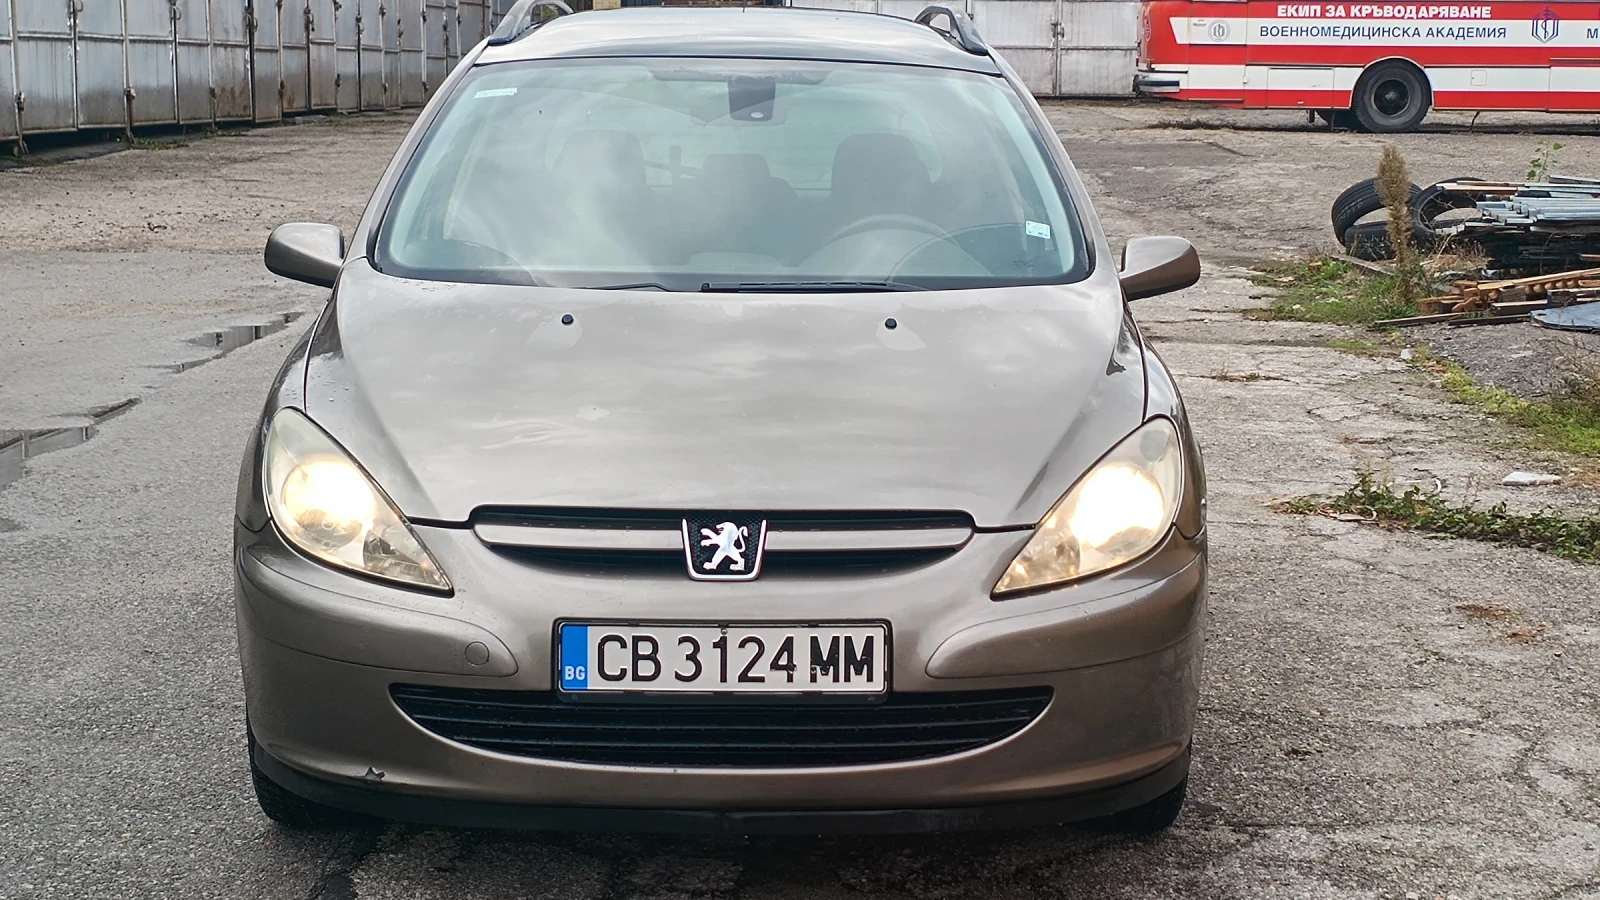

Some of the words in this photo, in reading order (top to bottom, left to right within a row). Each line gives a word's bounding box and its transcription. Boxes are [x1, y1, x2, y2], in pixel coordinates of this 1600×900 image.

[1277, 5, 1321, 17] ЕКИП
[1325, 5, 1346, 17] ЗА
[1350, 5, 1491, 19] КРЪВОДАРЯВАНЕ
[1260, 26, 1420, 39] ВОЕННОМЕДИЦИНСКА
[1425, 27, 1507, 40] АКАДЕМИЯ
[1586, 28, 1600, 39] М
[597, 634, 662, 682] CB
[674, 635, 797, 683] 3124
[809, 635, 874, 683] MM
[564, 665, 585, 680] BG
